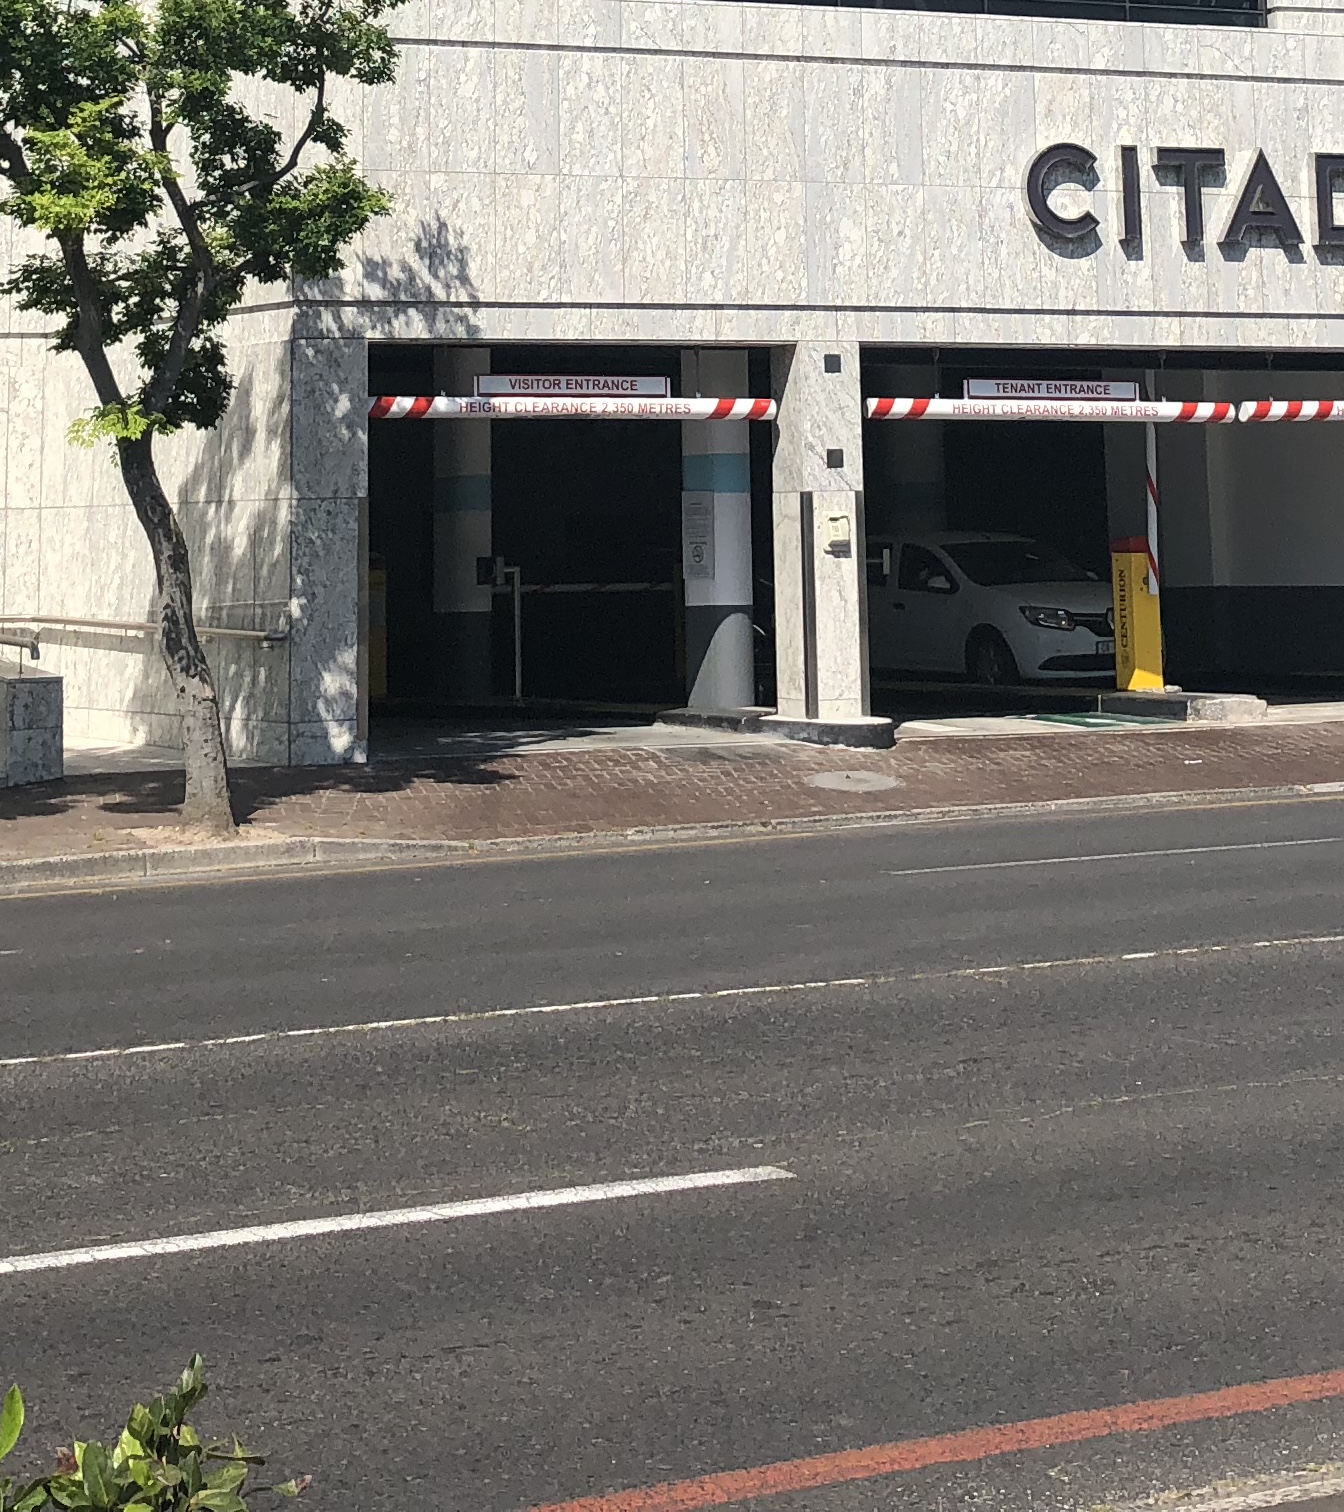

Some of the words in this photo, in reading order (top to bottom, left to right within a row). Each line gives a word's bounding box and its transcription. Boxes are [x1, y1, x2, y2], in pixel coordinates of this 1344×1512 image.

[508, 377, 562, 390] VISITOR
[565, 378, 639, 391] ENTRANCE
[994, 382, 1044, 394] TENANT
[1046, 383, 1112, 396] ENTRANCE
[459, 401, 509, 413] HEIGHT
[514, 401, 597, 414] CLEARANCE
[637, 402, 692, 414] METRES
[952, 403, 997, 415] HEIGHT
[1001, 403, 1074, 416] CLEARANCE
[1110, 405, 1159, 417] METRES
[1118, 569, 1128, 648] CENTURION
